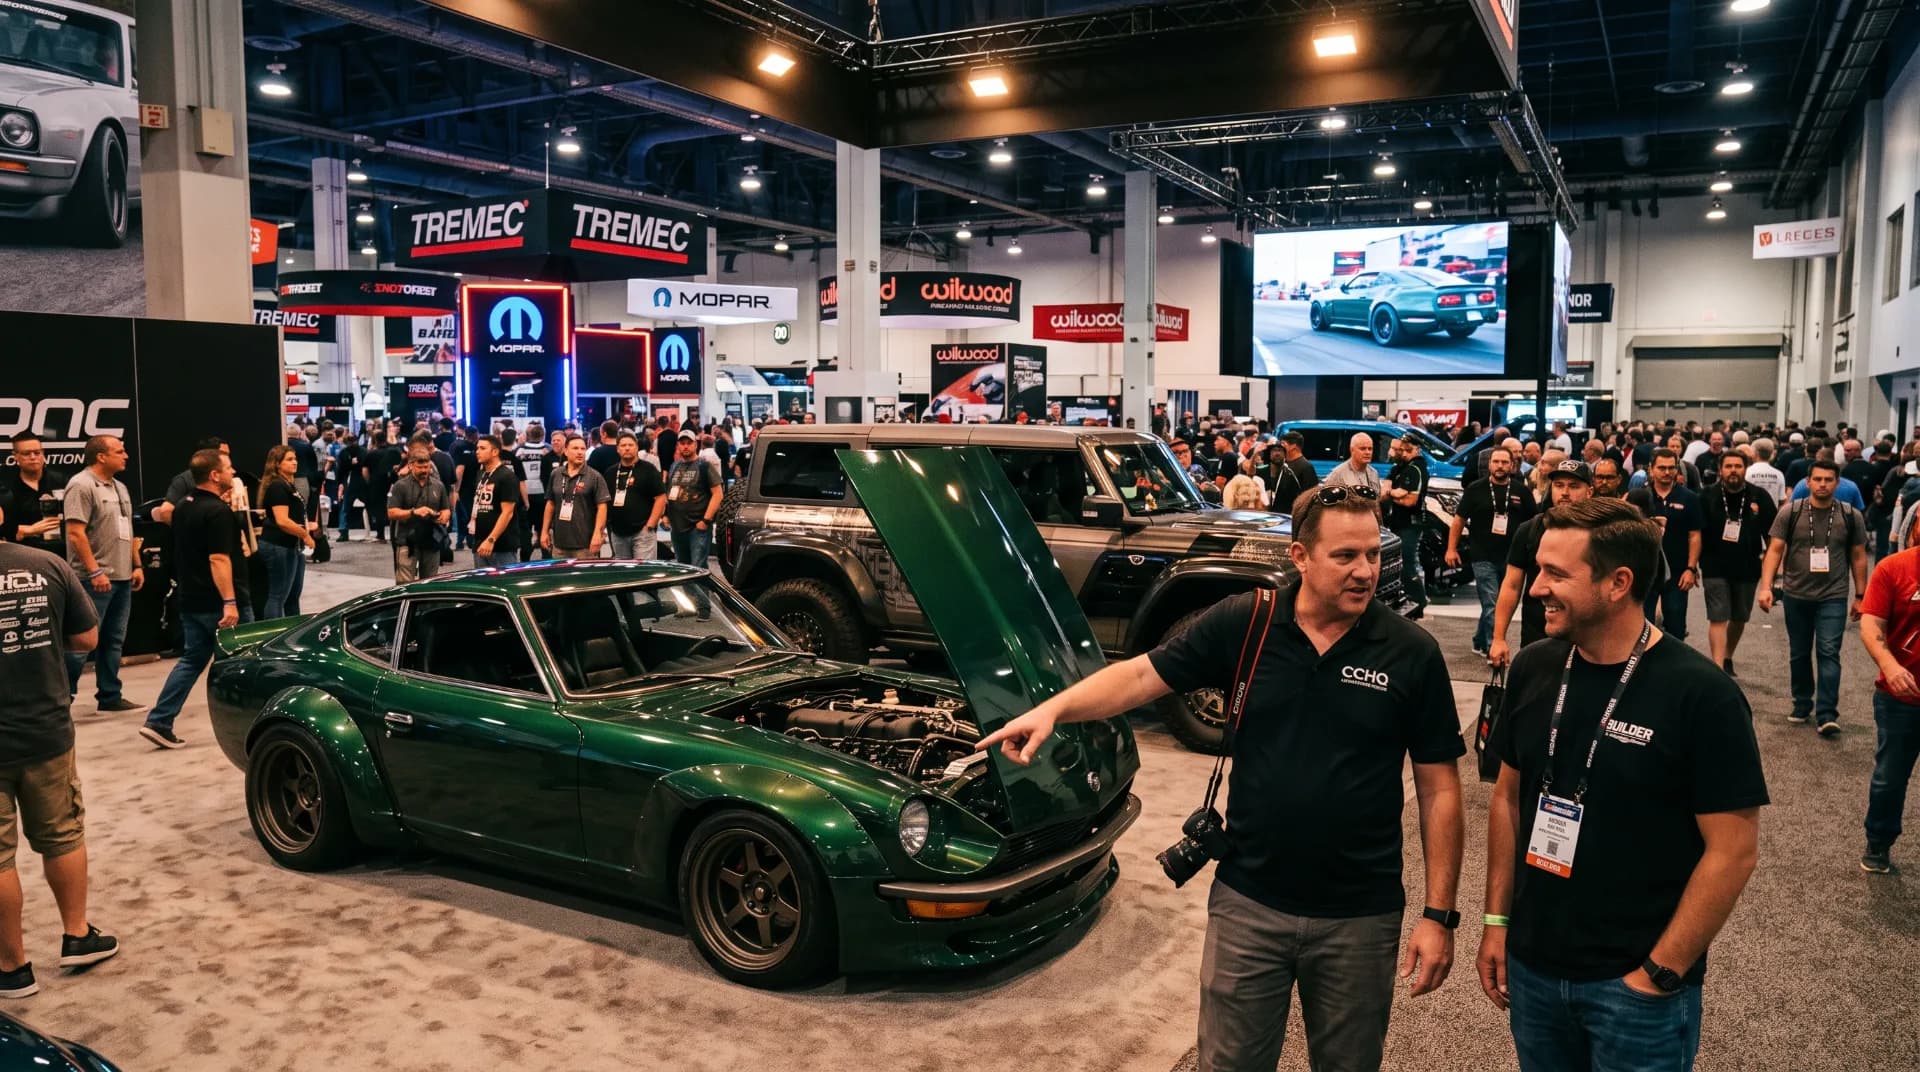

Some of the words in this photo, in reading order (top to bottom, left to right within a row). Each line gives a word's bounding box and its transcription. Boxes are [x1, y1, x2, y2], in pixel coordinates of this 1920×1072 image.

[411, 201, 526, 245] TREMEC
[573, 203, 691, 252] TREMEC
[680, 292, 770, 309] MOPAR
[920, 277, 1013, 304] wilwood
[253, 308, 320, 327] TREMEC
[408, 383, 439, 393] TREMEC
